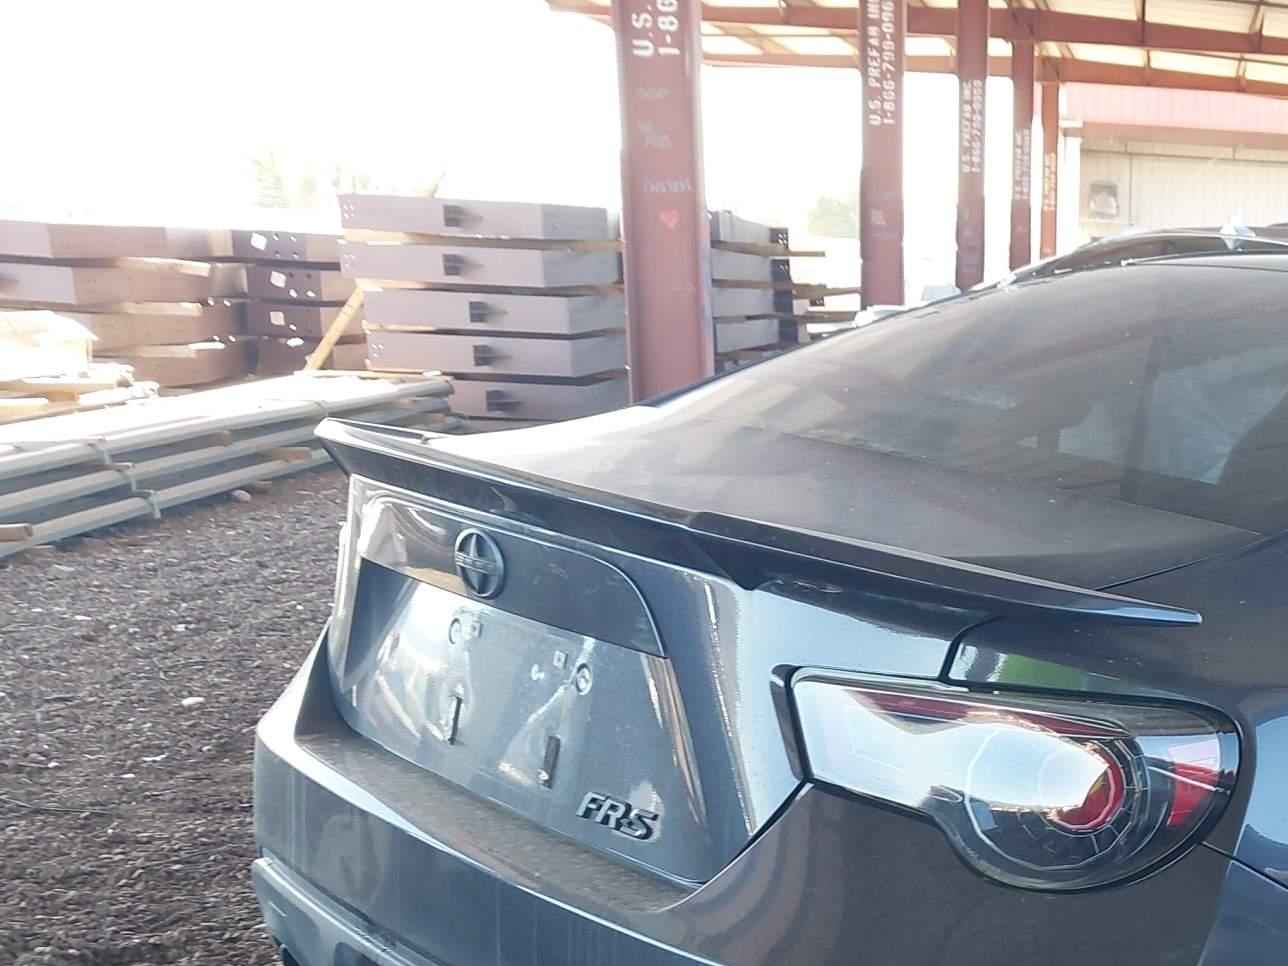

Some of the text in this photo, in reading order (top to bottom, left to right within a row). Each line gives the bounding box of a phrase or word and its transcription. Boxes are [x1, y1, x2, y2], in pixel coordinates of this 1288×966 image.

[631, 4, 654, 57] U.S.
[866, 0, 882, 126] U.S. PREFAB IN
